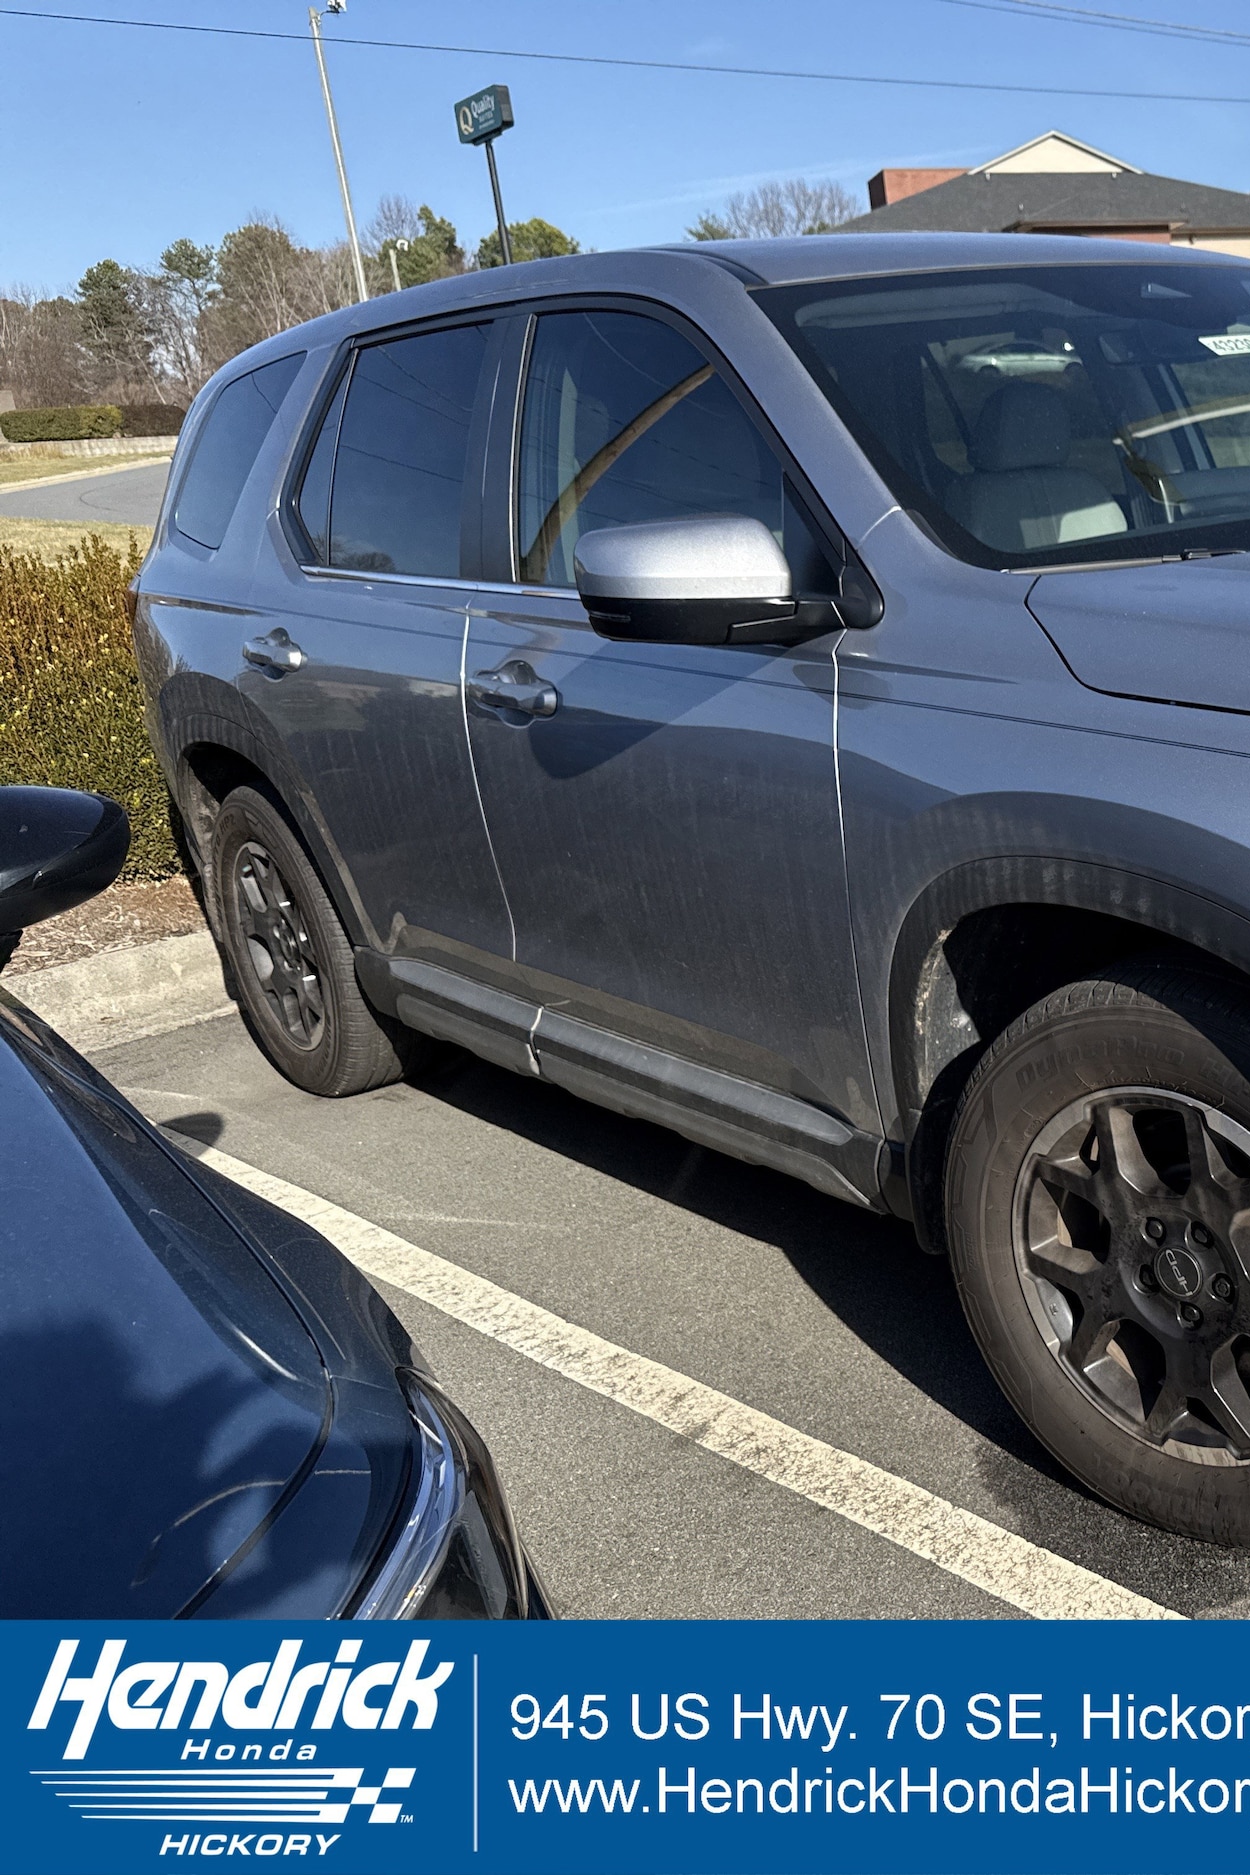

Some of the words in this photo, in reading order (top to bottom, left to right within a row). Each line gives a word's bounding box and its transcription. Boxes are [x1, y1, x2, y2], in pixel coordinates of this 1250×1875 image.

[459, 106, 474, 135] Q
[470, 94, 495, 118] Quality
[1165, 1249, 1194, 1297] HPD
